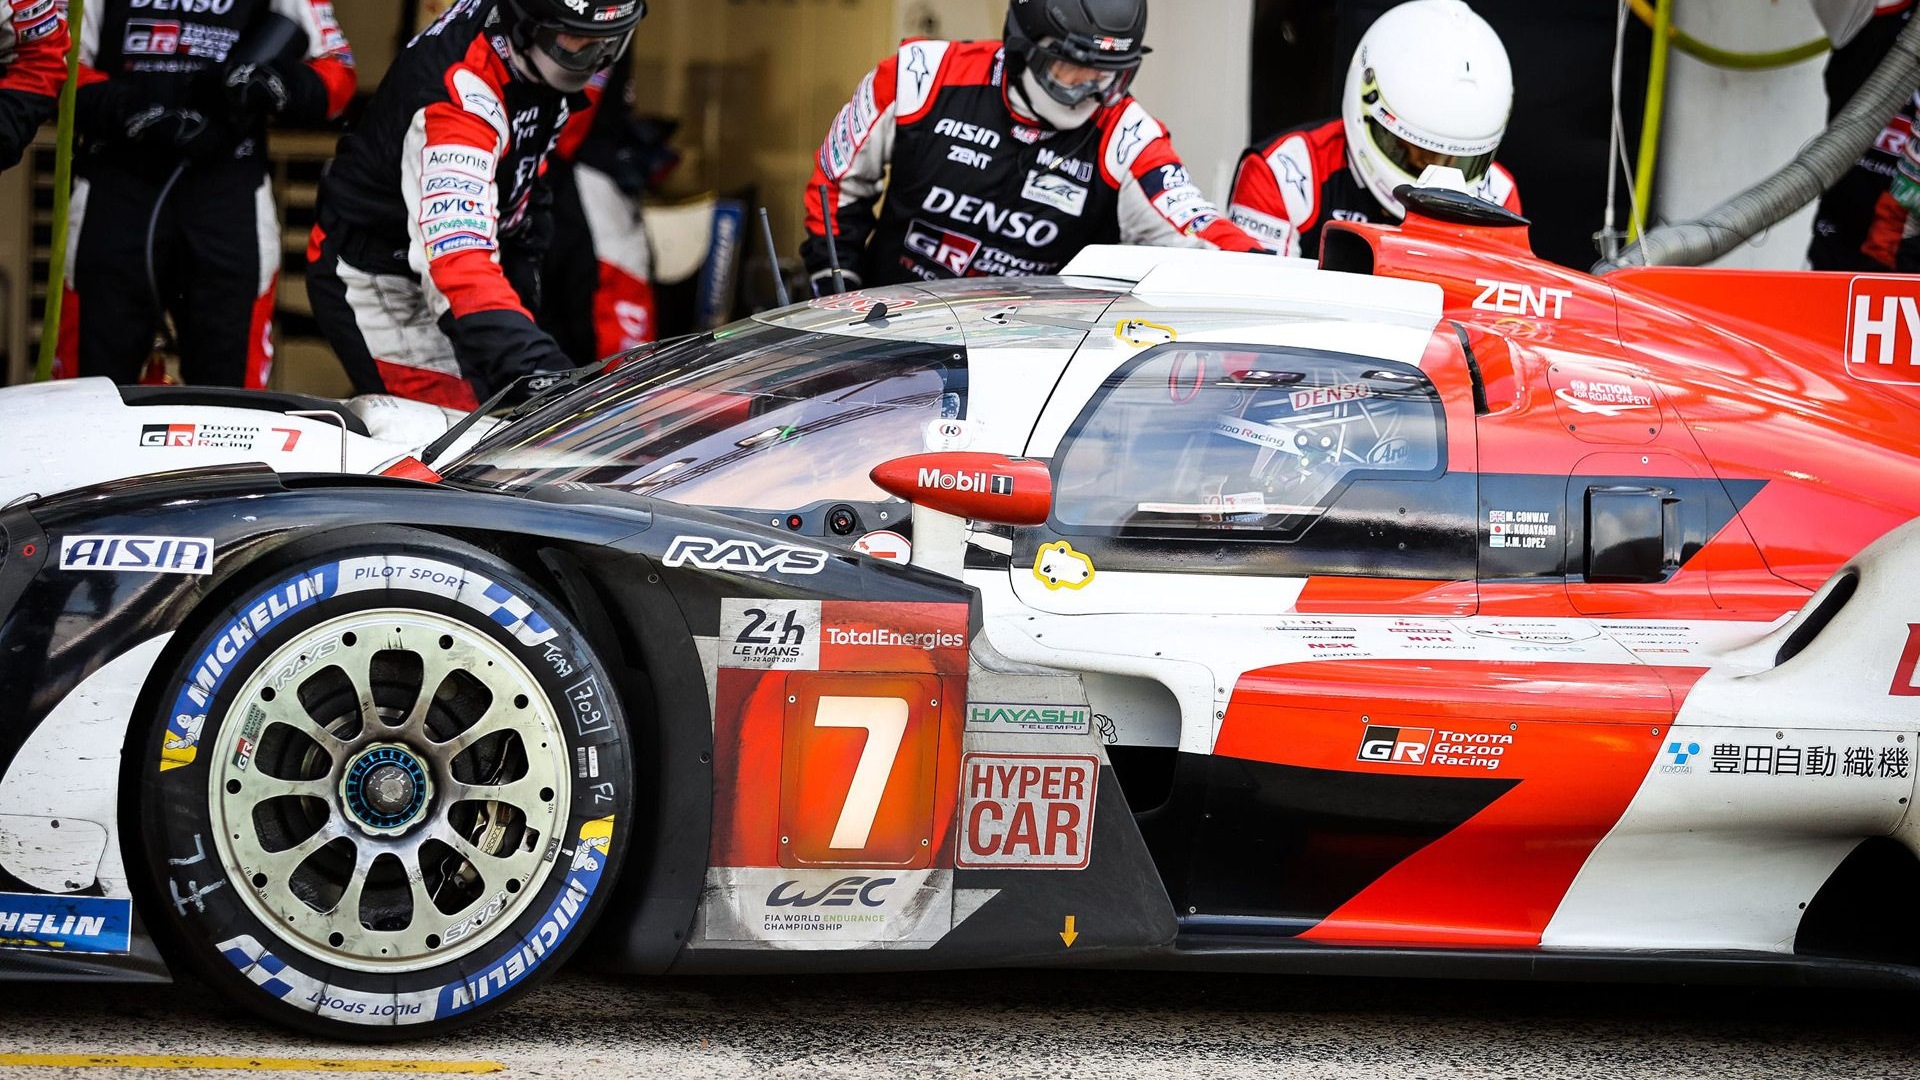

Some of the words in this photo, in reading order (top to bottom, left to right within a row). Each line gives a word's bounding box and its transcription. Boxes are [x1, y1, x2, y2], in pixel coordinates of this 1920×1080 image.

[125, 32, 178, 52] GR
[934, 118, 1000, 149] AISIN
[428, 152, 488, 171] Acronis
[947, 145, 992, 170] ZENT
[922, 186, 1058, 247] DENSO
[907, 232, 969, 272] GR
[1471, 278, 1572, 320] ZENT
[1295, 383, 1369, 409] DENSO
[1573, 391, 1588, 399] FOR
[1588, 392, 1615, 403] ROAD
[1616, 395, 1651, 406] SAFETY
[1589, 382, 1632, 395] ACTION
[141, 430, 193, 447] GR
[199, 431, 254, 440] GAZOO
[200, 424, 258, 432] TOYOTA
[271, 427, 302, 452] 7
[1241, 428, 1285, 448] Racing
[198, 440, 252, 450] Racing
[917, 467, 987, 493] Mobil
[1506, 512, 1515, 522] M.
[1516, 512, 1549, 522] CONWAY
[1515, 524, 1556, 535] KOBAYASHI
[64, 538, 208, 570] AISIN
[1523, 537, 1546, 548] LOPEZ
[662, 535, 828, 575] RAYS
[355, 565, 406, 581] PILOT
[410, 567, 470, 591] SPORT
[736, 608, 805, 644] 24h
[187, 572, 325, 708] MICHELIN
[826, 628, 964, 650] TotalEnergies
[732, 646, 752, 656] LE
[755, 646, 800, 657] MANS
[743, 655, 761, 663] 21-22
[275, 636, 341, 692] RAYS
[573, 686, 602, 725] 709
[972, 707, 1084, 725] HAYASHI
[242, 704, 258, 736] TOYOTA
[247, 709, 261, 739] GAZOO
[1434, 743, 1504, 755] GAZOO
[1438, 731, 1513, 744] TOYOTA
[237, 741, 253, 771] GR
[1361, 739, 1426, 762] GR
[1430, 754, 1500, 770] Racing
[1709, 743, 1910, 778] 豊田自動織機
[814, 695, 910, 849] 7
[1659, 765, 1692, 774] TOYOTA
[970, 765, 1085, 801] HYPER
[967, 801, 1083, 857] CAR
[765, 876, 897, 908] WEC
[442, 890, 508, 947] RAYS
[764, 914, 781, 922] FIA
[784, 914, 821, 922] WORLD
[823, 914, 885, 923] ENDURANCE
[764, 923, 843, 931] CHAMPIONSHIP
[451, 877, 588, 1010] MICHELIN
[306, 991, 367, 1015] SPORT
[369, 1002, 422, 1017] PILOT
